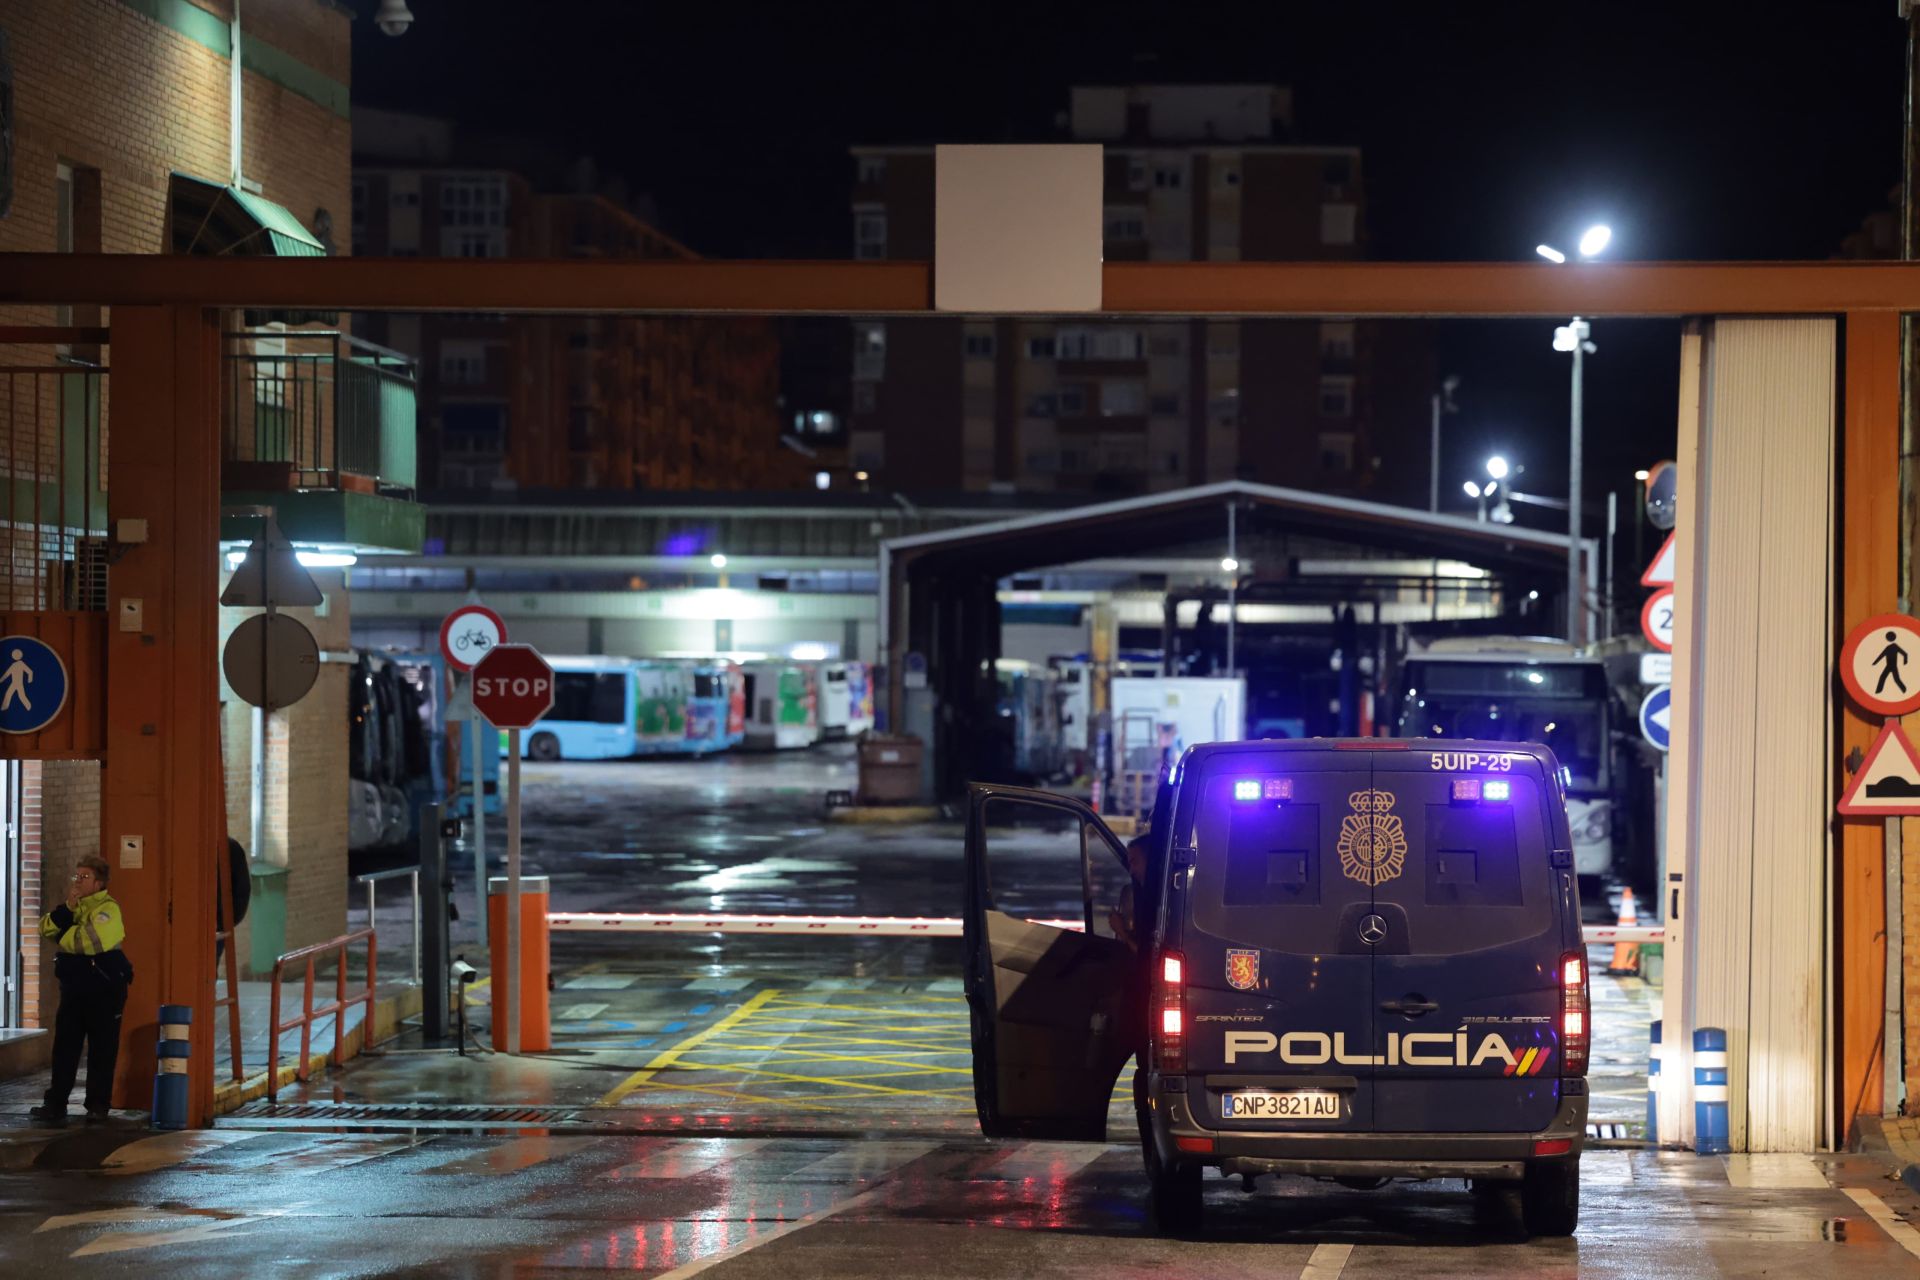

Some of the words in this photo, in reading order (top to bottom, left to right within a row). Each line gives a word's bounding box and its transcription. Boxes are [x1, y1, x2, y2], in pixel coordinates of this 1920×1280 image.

[1660, 608, 1673, 629] 2
[476, 677, 548, 697] STOP
[1431, 753, 1512, 772] 5UIP-29
[1225, 1025, 1518, 1066] POLICÍA
